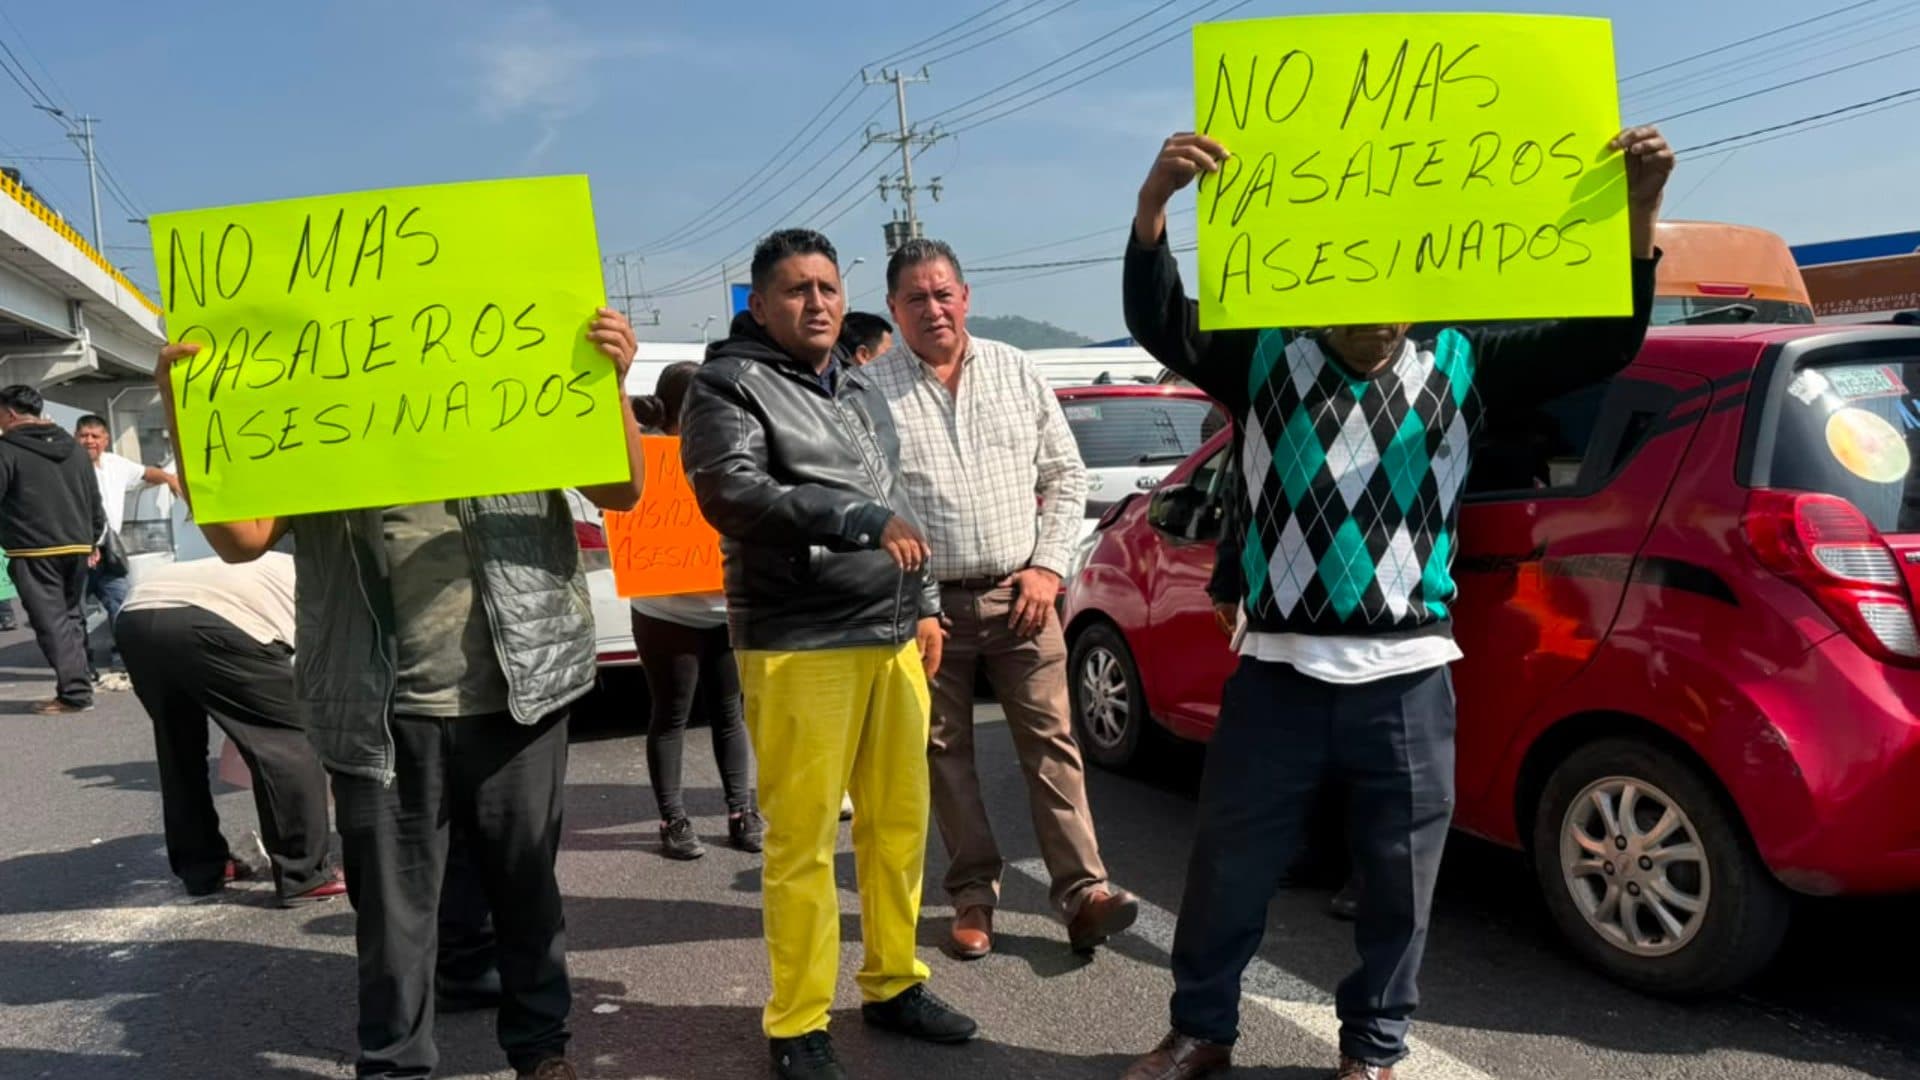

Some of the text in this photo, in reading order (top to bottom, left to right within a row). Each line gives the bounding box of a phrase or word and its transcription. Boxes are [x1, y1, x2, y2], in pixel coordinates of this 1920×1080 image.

[1203, 39, 1500, 134] NO MAS
[1199, 131, 1585, 227] PASAJEROS
[168, 205, 440, 313] NO MAS
[1219, 218, 1592, 303] ASESINADOS
[172, 303, 546, 409] PASAJEROS
[204, 371, 597, 475] ASESINADOS
